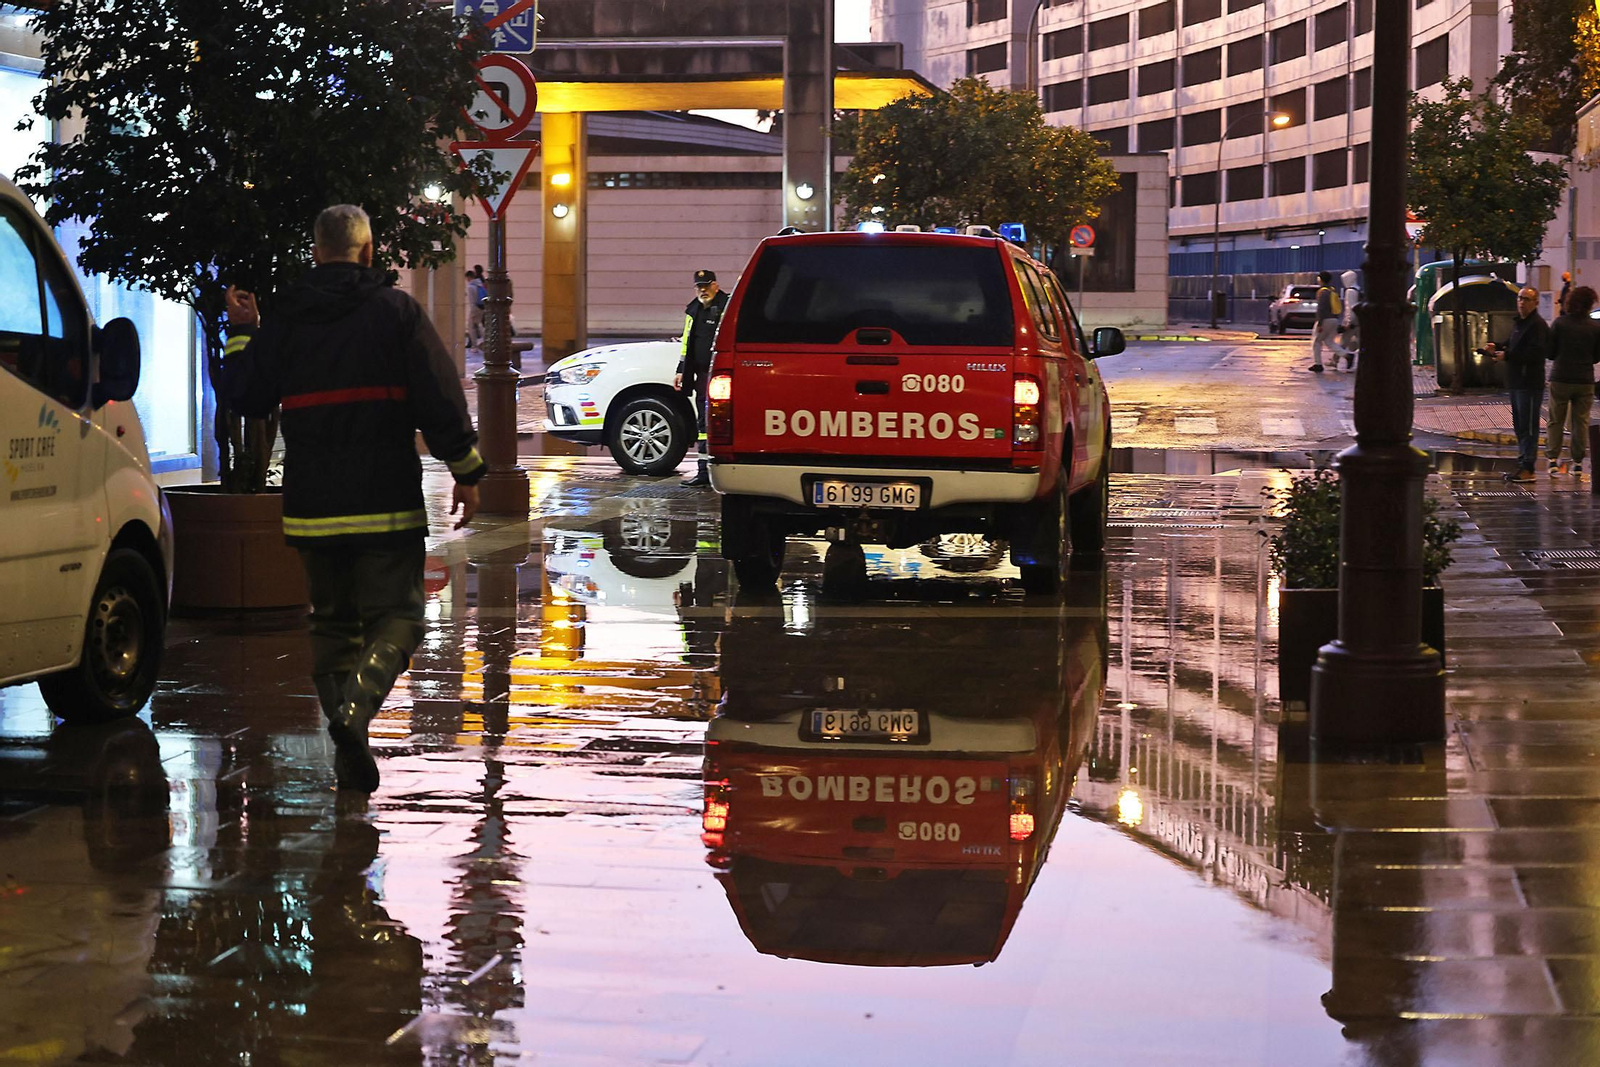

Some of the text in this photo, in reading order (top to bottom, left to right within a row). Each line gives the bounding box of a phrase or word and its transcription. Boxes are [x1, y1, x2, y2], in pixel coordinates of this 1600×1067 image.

[966, 363, 1007, 372] HILUX
[923, 374, 965, 393] 080
[764, 409, 980, 440] BOMBEROS
[9, 438, 35, 459] SPORT
[827, 484, 916, 504] 6199 GMG
